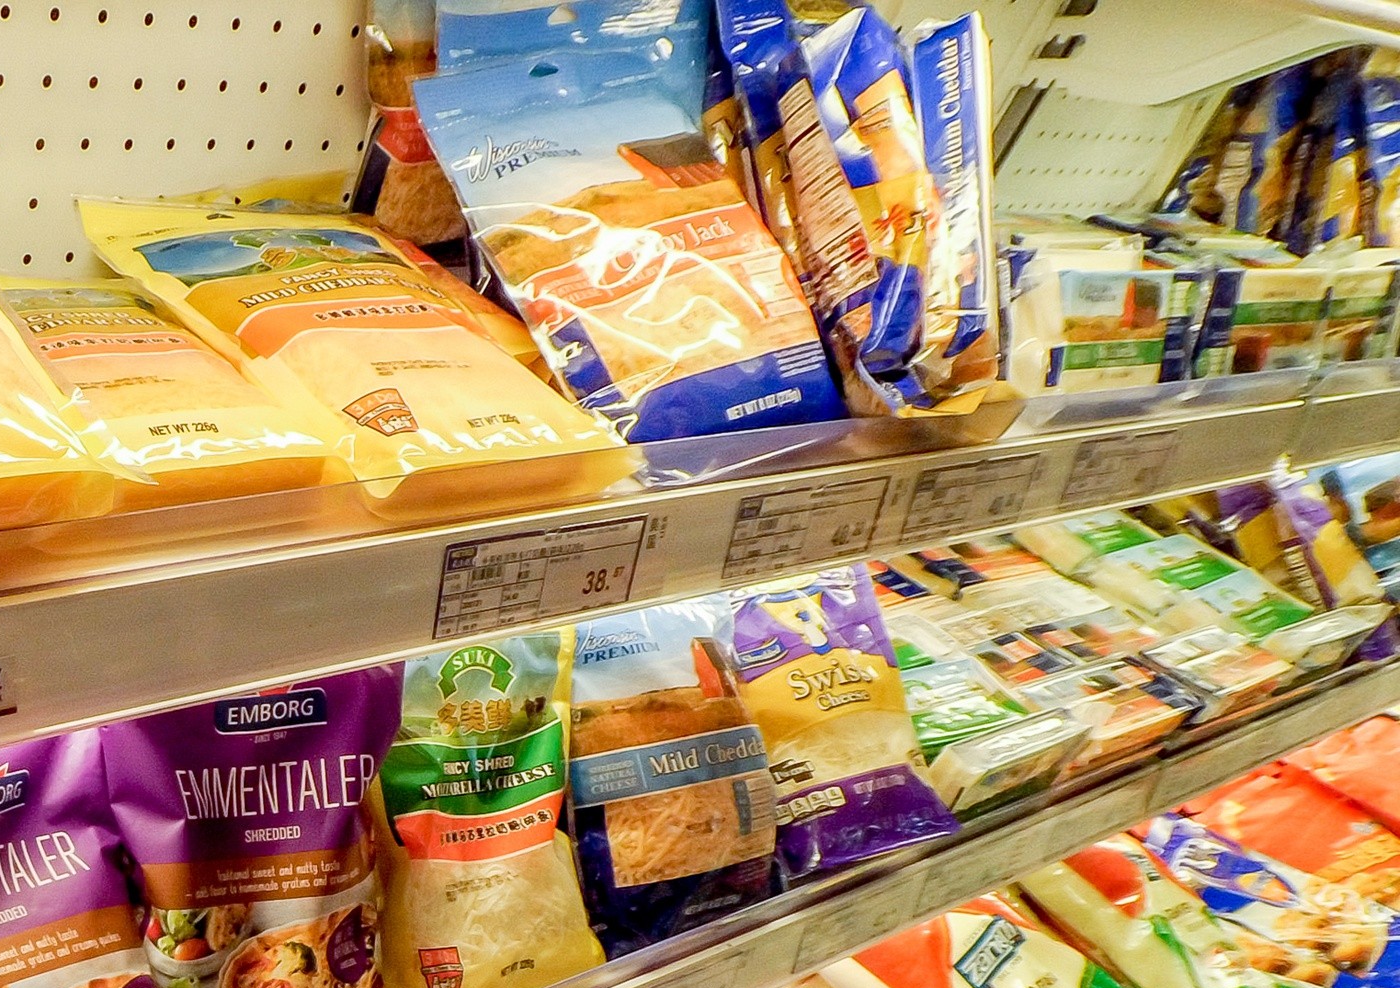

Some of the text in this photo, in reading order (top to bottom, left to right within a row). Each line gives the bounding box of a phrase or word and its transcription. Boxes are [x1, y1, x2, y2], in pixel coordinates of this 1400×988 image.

[936, 37, 961, 119] Cheddar
[452, 135, 558, 184] Wisconsin
[494, 147, 581, 180] PREMIUM
[686, 215, 736, 248] Jack
[281, 267, 341, 285] FANCY
[239, 275, 387, 309] MILD CHEDDAR
[148, 421, 220, 437] NET WT 226g
[451, 649, 496, 671] SUKI
[581, 641, 661, 665] PREMIUM
[787, 658, 878, 701] Swiss
[226, 697, 315, 726] EMBORG
[815, 689, 872, 711] Cheese
[436, 698, 513, 737] 多美鲜
[474, 755, 516, 773] SHRED
[496, 762, 556, 789] CHEESE
[648, 751, 700, 777] Mild
[175, 753, 375, 821] EMMENTALER
[244, 825, 301, 844] SHREDDED
[279, 863, 294, 876] and
